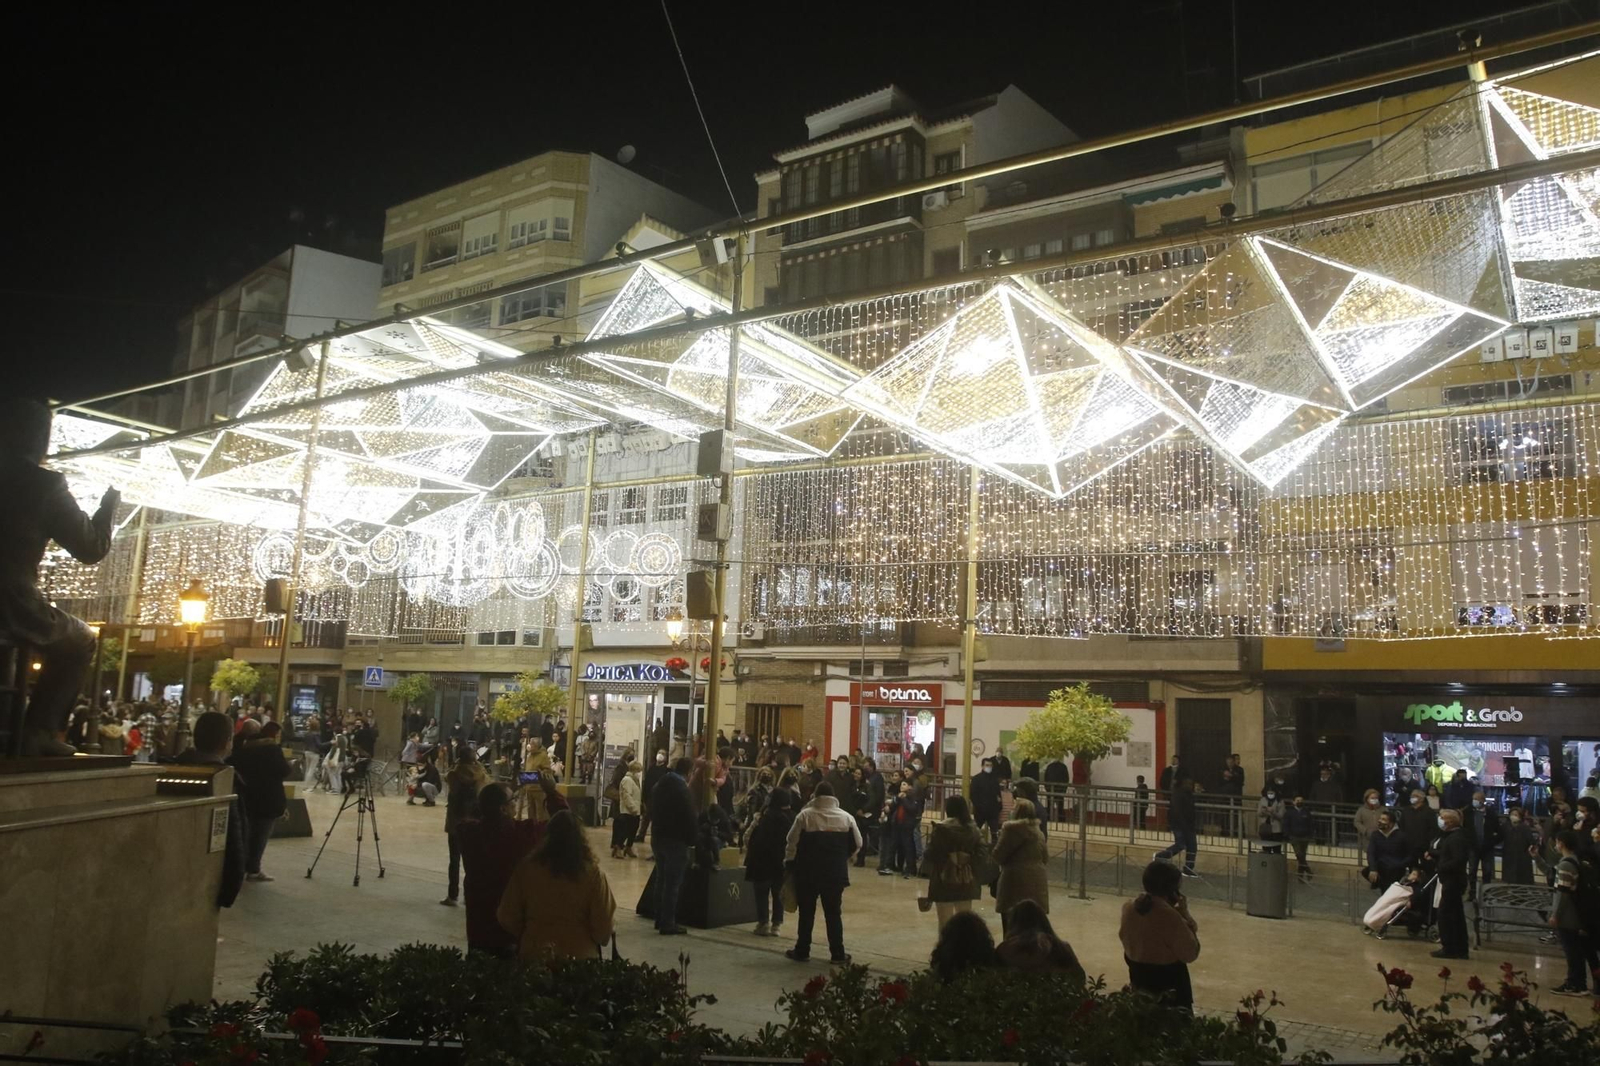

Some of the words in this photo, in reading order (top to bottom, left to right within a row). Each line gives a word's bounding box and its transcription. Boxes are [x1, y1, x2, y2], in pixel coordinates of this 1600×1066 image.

[586, 663, 635, 680] OPTICA
[1404, 700, 1464, 725] sport
[1466, 709, 1478, 722] &
[1479, 706, 1524, 722] Grab
[1477, 741, 1512, 752] CONQUER
